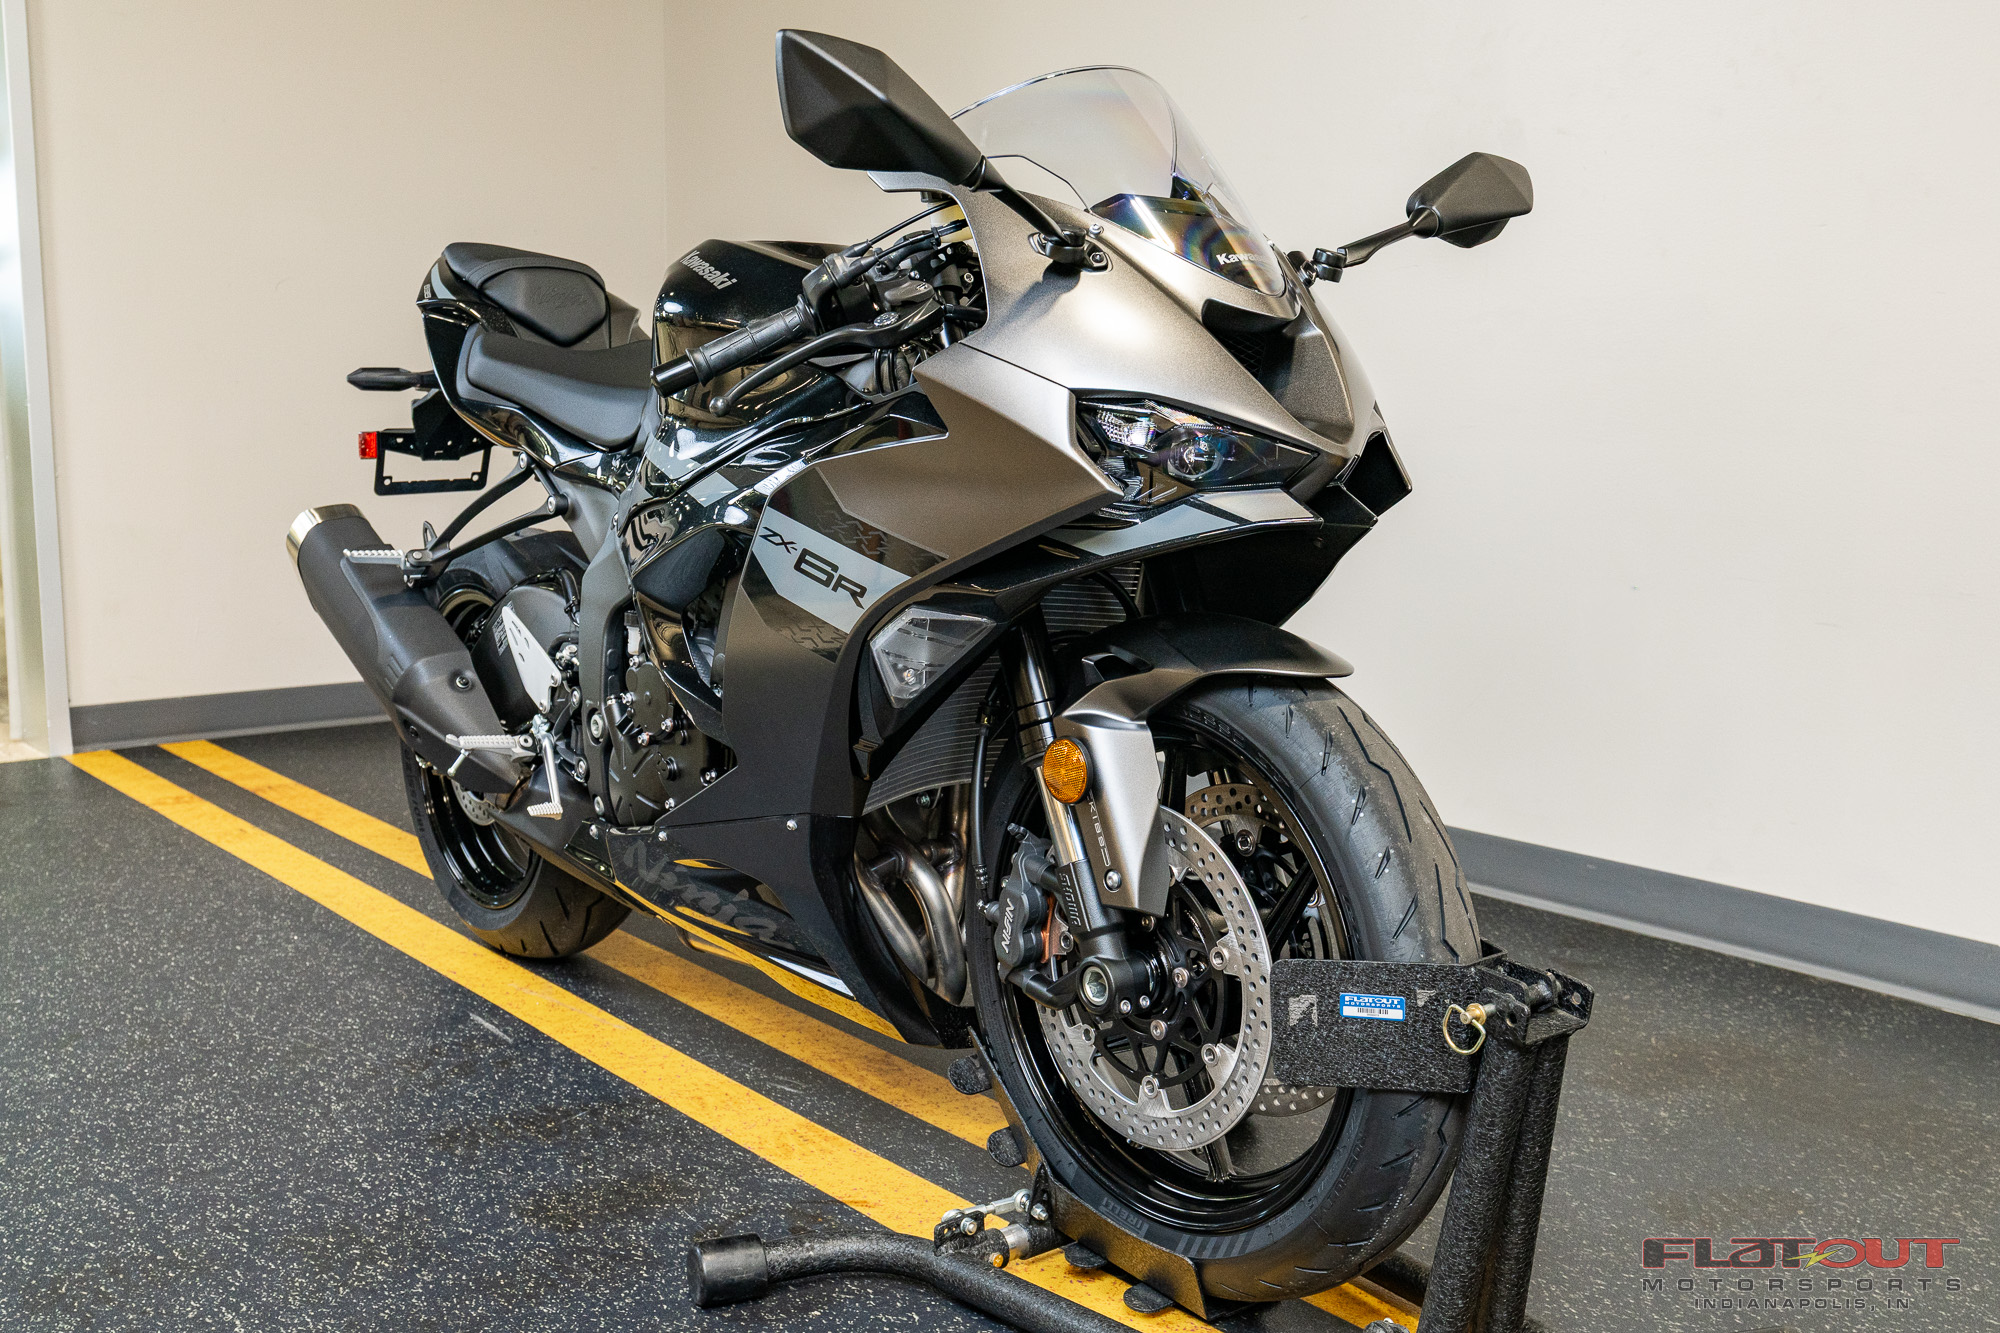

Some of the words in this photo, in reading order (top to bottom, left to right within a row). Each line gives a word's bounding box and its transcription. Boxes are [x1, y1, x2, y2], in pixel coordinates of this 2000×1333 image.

[680, 250, 738, 290] Kawasaki
[759, 526, 868, 610] ZX-6R
[623, 840, 798, 951] Ninja
[1099, 1197, 1150, 1238] PIRELLI
